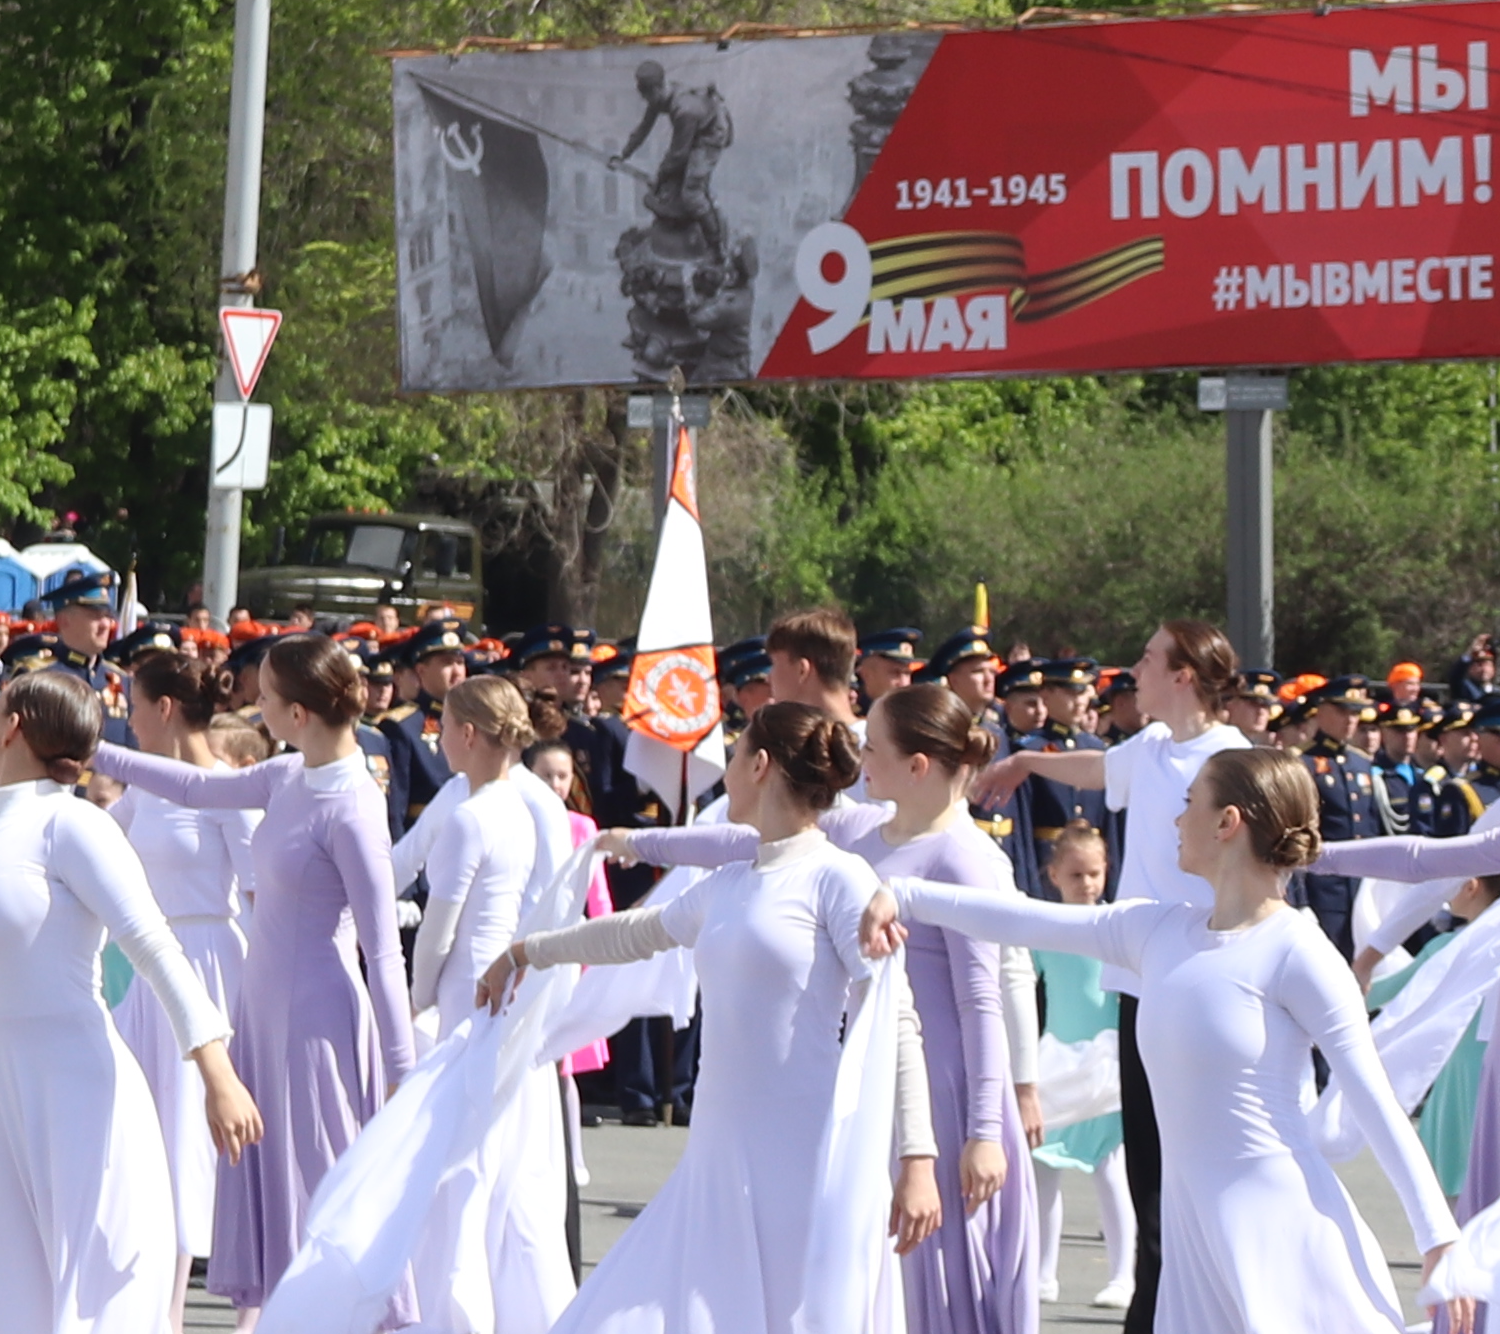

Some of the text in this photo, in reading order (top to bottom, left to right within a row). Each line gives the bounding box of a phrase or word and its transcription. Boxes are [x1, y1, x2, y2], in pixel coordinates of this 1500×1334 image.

[1349, 41, 1489, 117] МЫ
[895, 172, 1068, 211] 1941-1945
[1110, 134, 1493, 220] ПОМНИМ!
[795, 220, 1008, 355] 9 МАЯ
[1212, 255, 1494, 311] #МЫВМЕСТЕ
